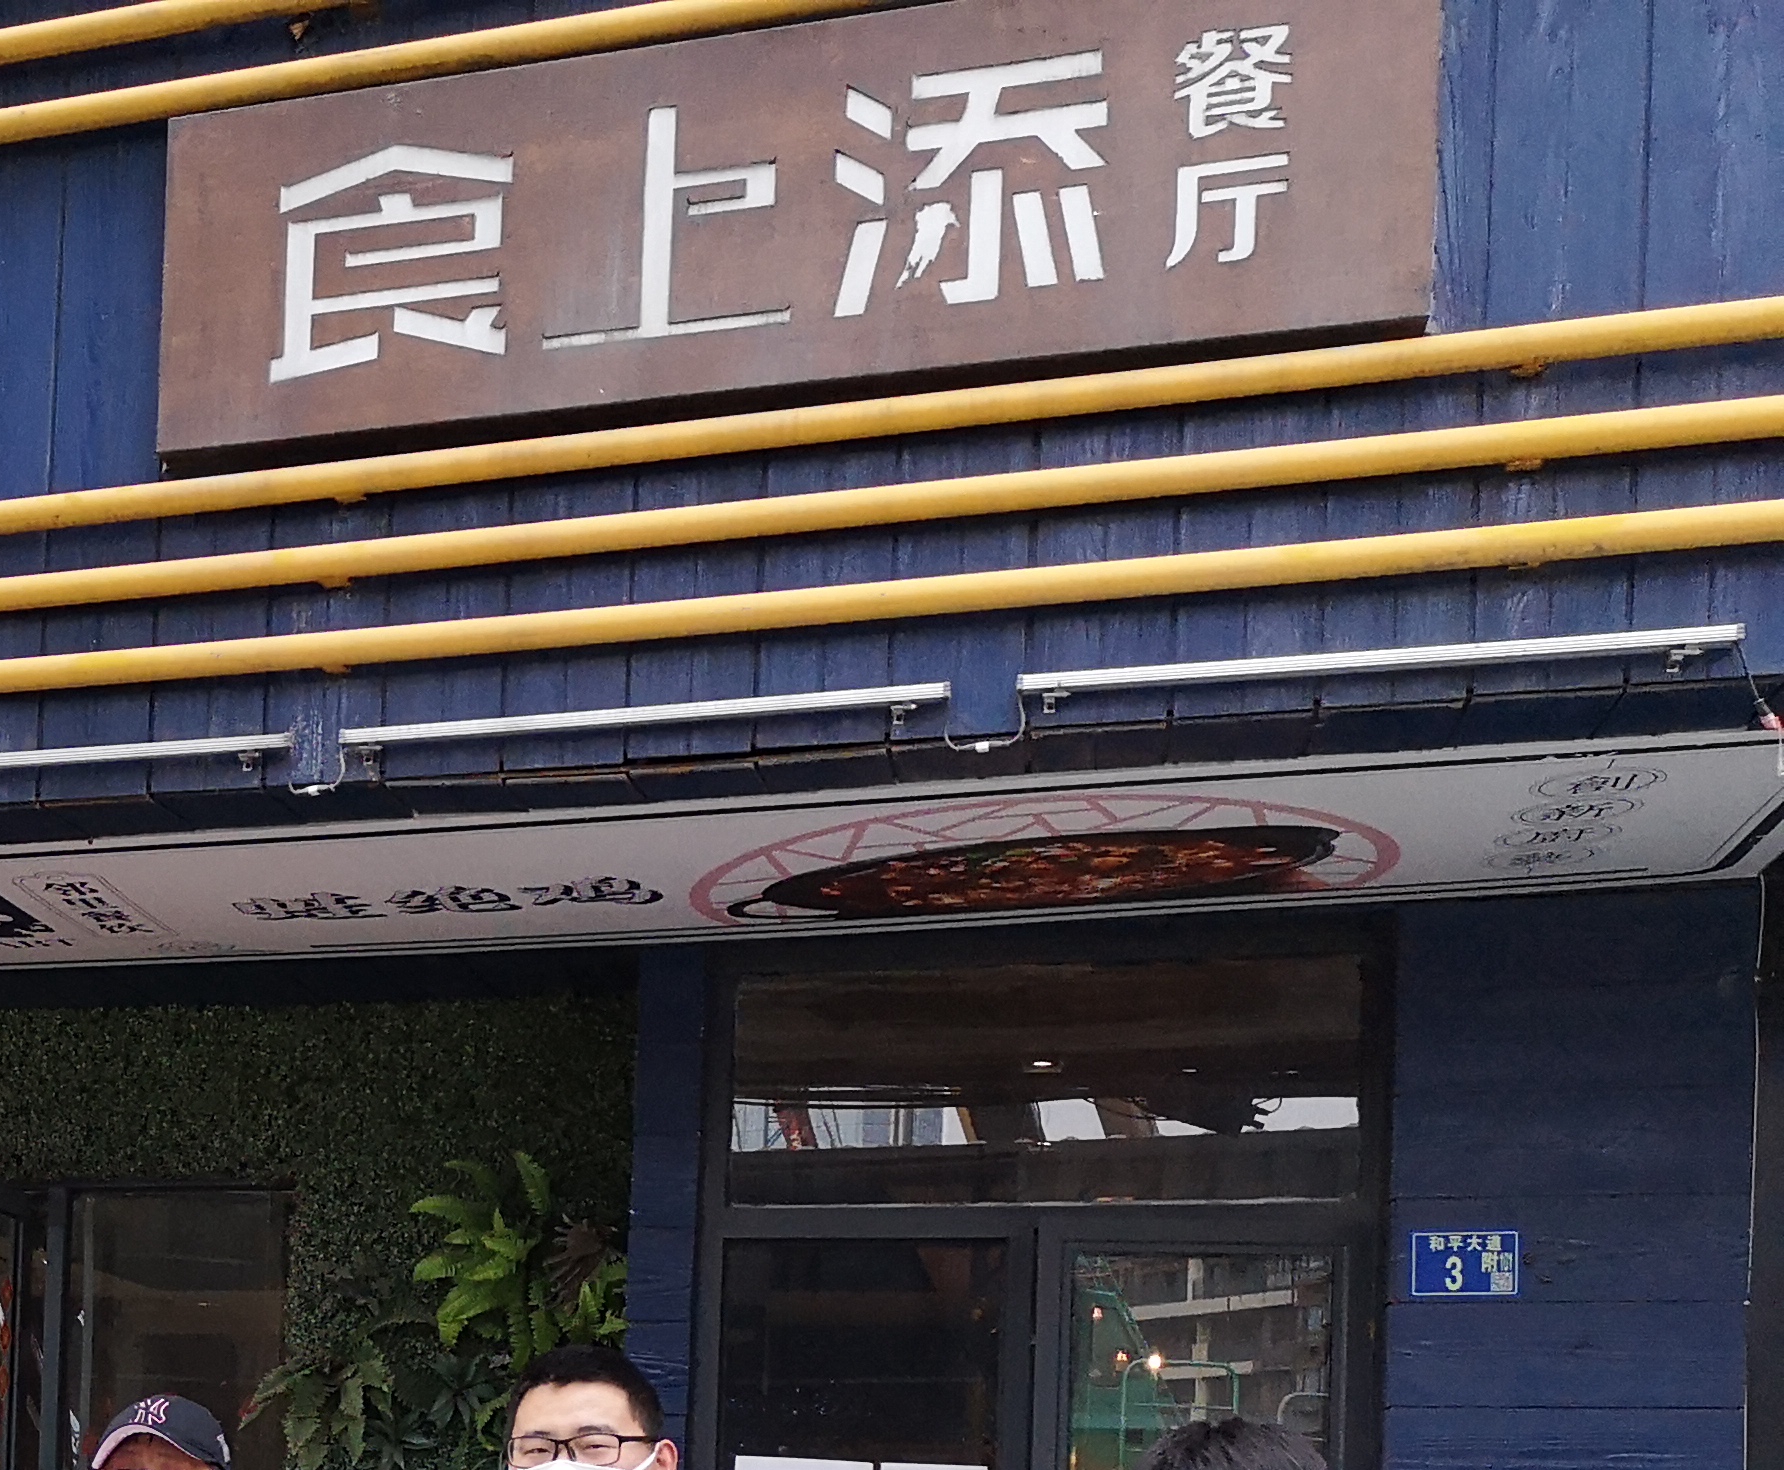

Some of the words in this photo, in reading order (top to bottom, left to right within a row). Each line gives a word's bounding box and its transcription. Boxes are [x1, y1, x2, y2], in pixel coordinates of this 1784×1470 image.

[269, 49, 1109, 383] 食上添
[1165, 24, 1293, 269] 餐厅
[1429, 1235, 1502, 1252] 和平大道
[1444, 1255, 1464, 1291] 3
